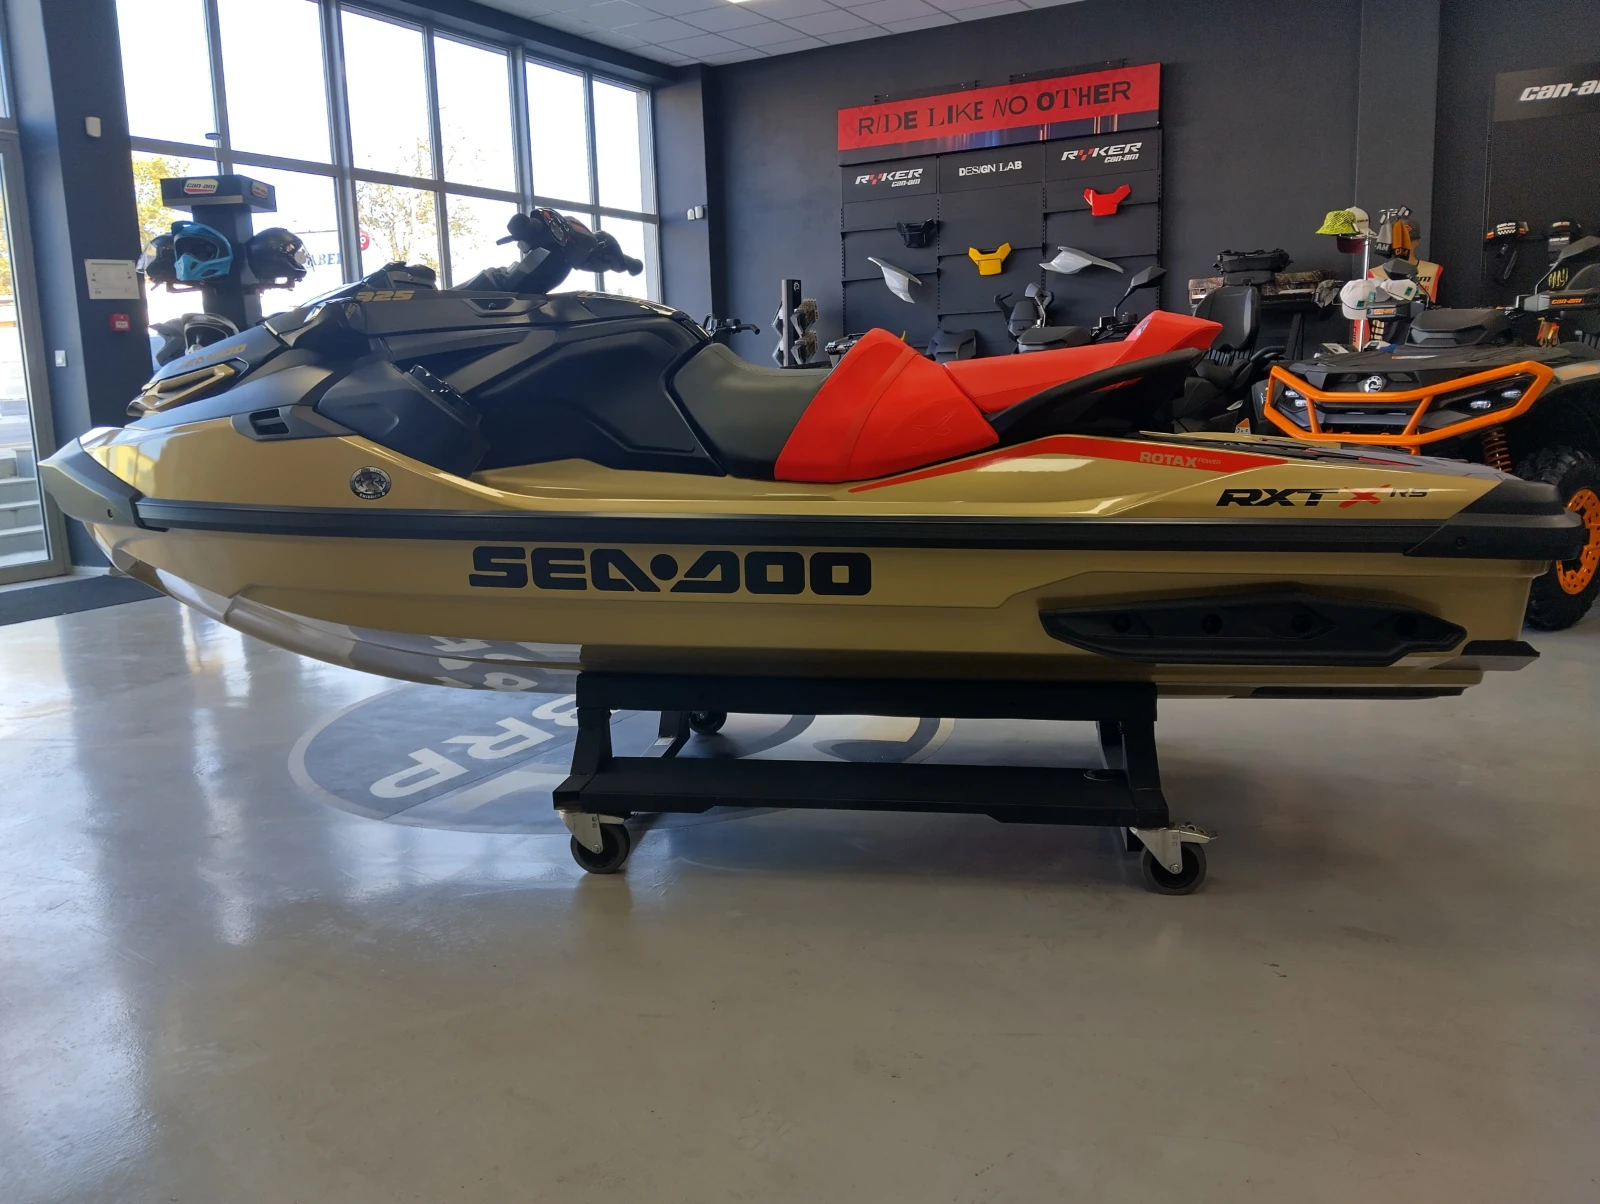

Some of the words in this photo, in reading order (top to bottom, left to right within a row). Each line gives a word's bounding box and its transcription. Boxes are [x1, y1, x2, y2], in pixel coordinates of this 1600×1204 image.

[857, 110, 918, 137] RIDE
[927, 101, 985, 128] LIKE
[992, 95, 1028, 118] NO
[1036, 80, 1133, 112] OTHER
[1061, 142, 1142, 161] RYKER
[1104, 153, 1140, 163] can-am
[855, 168, 923, 185] RYKER
[958, 163, 996, 177] DESIGN
[999, 160, 1023, 173] LAB
[186, 182, 216, 190] can-am
[891, 178, 921, 187] can-am
[1140, 451, 1198, 468] ROTAX
[1198, 457, 1221, 465] POWER
[1215, 488, 1339, 507] RXT
[1389, 487, 1430, 498] RS
